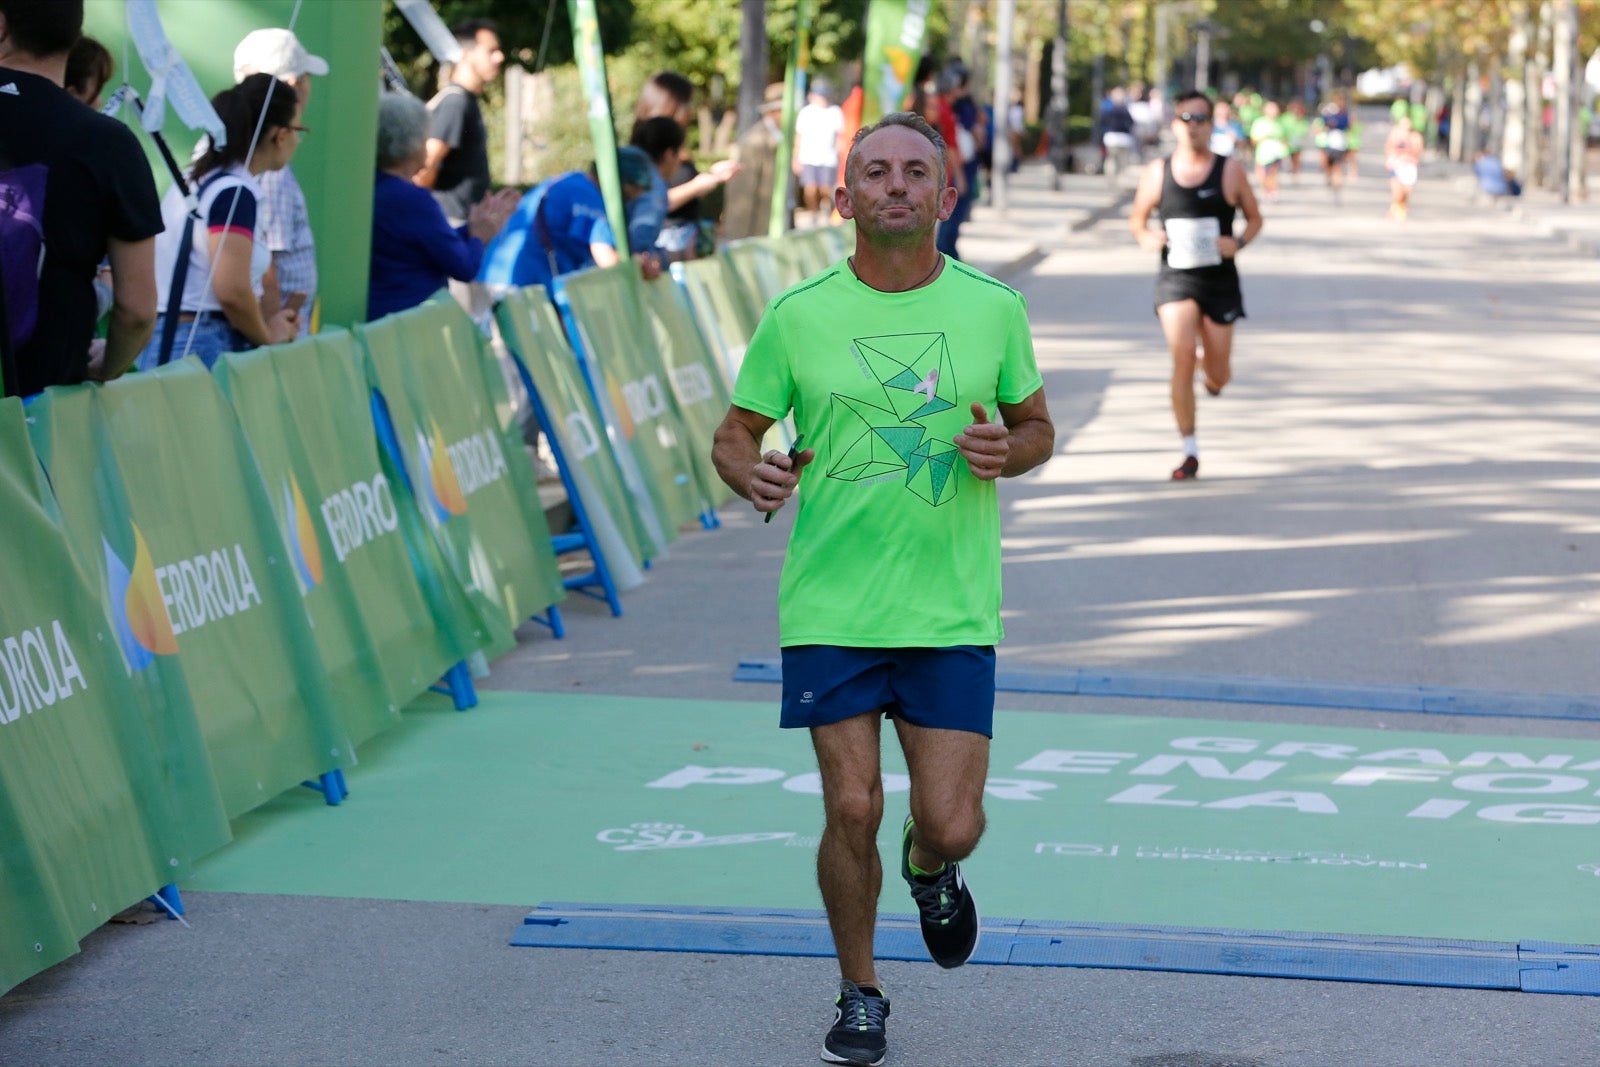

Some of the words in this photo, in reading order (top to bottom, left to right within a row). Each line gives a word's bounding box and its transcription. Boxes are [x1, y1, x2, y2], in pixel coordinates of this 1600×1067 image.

[0, 619, 88, 725] DROLA
[1014, 749, 1288, 781] EN
[1331, 765, 1600, 797] FO
[1103, 783, 1340, 814] LA
[595, 827, 706, 847] CSD
